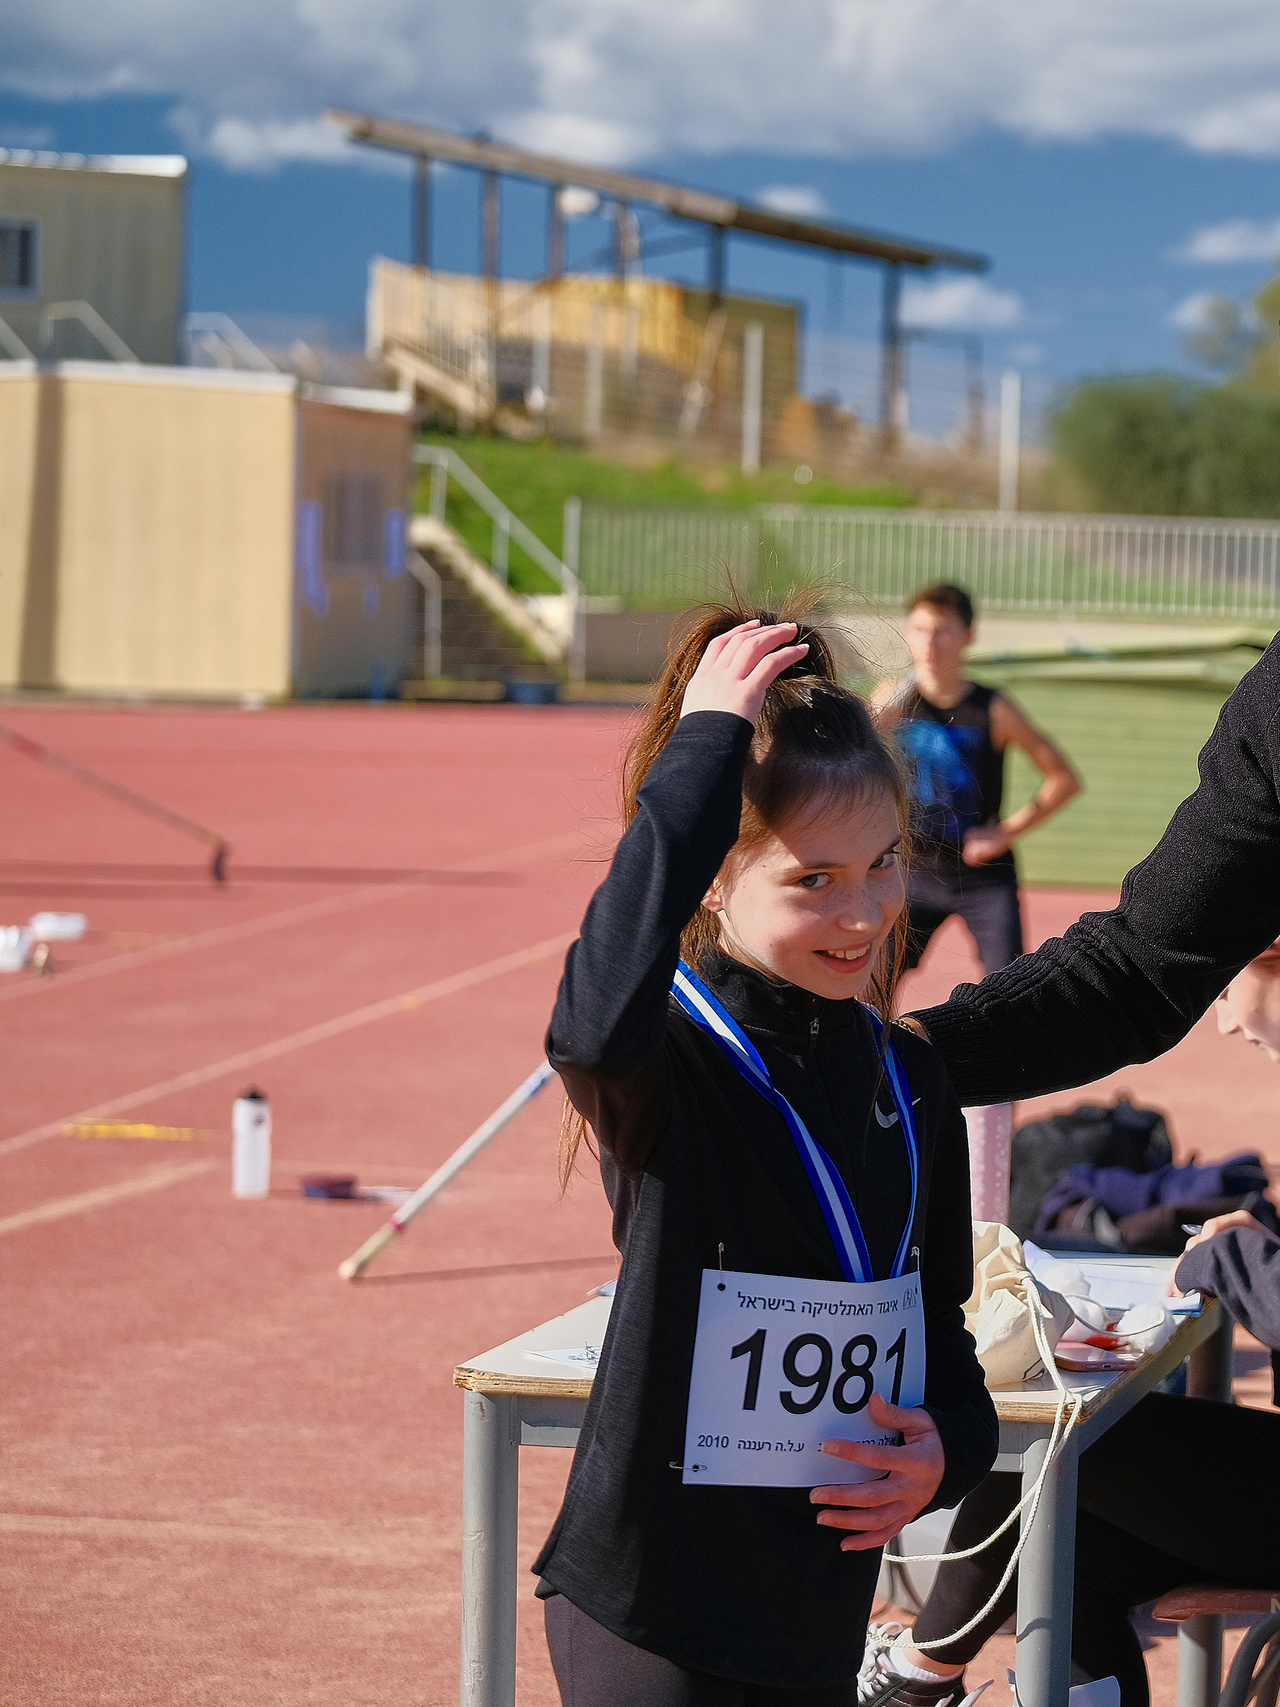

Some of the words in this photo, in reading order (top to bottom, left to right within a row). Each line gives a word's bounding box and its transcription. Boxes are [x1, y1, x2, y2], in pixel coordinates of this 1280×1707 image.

[737, 1290, 796, 1312] בישראל
[801, 1299, 874, 1317] האתלטיקה
[877, 1298, 899, 1314] איגוד
[729, 1326, 908, 1415] 1981
[697, 1434, 730, 1448] 2010
[737, 1439, 772, 1451] רעננה
